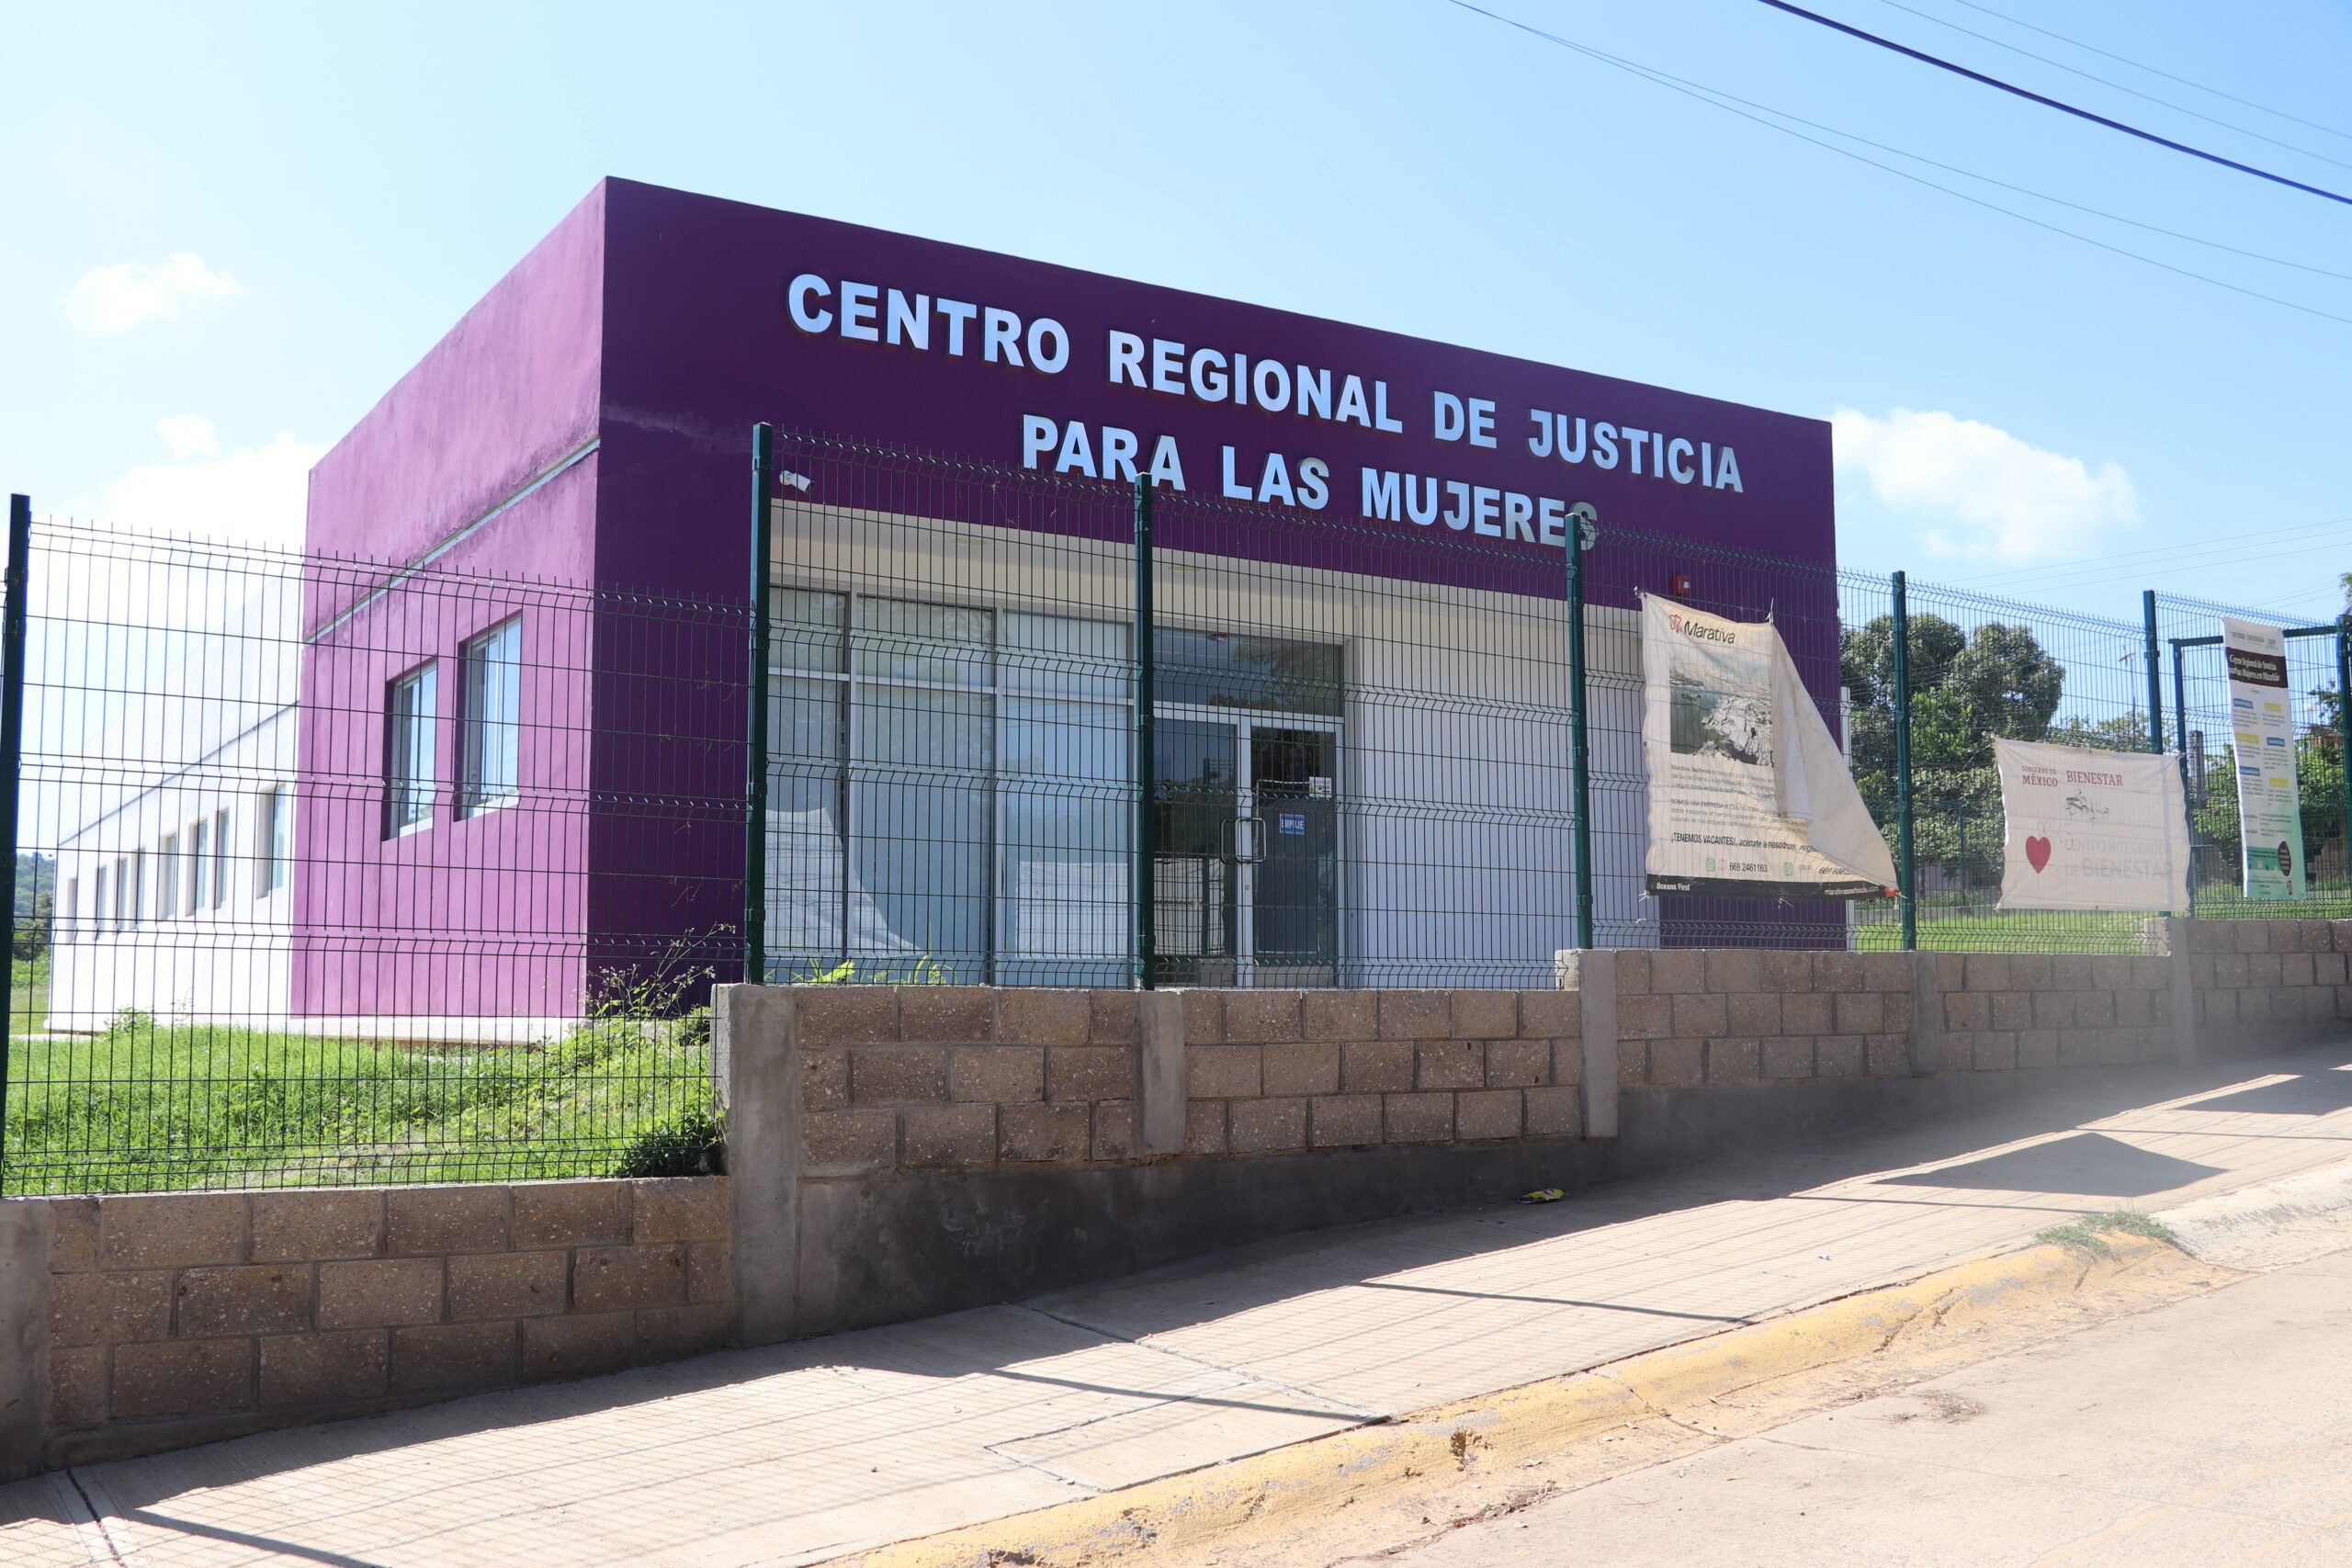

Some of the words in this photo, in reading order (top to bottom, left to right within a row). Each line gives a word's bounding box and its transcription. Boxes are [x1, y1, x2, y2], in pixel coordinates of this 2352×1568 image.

[786, 273, 1070, 375] CENTRO
[1108, 329, 1404, 434] REGIONAL
[1432, 389, 1498, 450] DE
[1527, 408, 1745, 494] JUSTICIA
[1022, 412, 1187, 492] PARA
[1221, 444, 1330, 511] LAS
[1361, 466, 1598, 552] MUJERES
[1684, 621, 1736, 644] Marativa
[2021, 765, 2048, 774] GOBIERNO
[2022, 773, 2058, 787] MÉXICO
[2066, 771, 2124, 786] BIENESTAR
[1729, 862, 1741, 872] 669
[1657, 882, 1677, 891] Oceans
[1678, 883, 1690, 891] First
